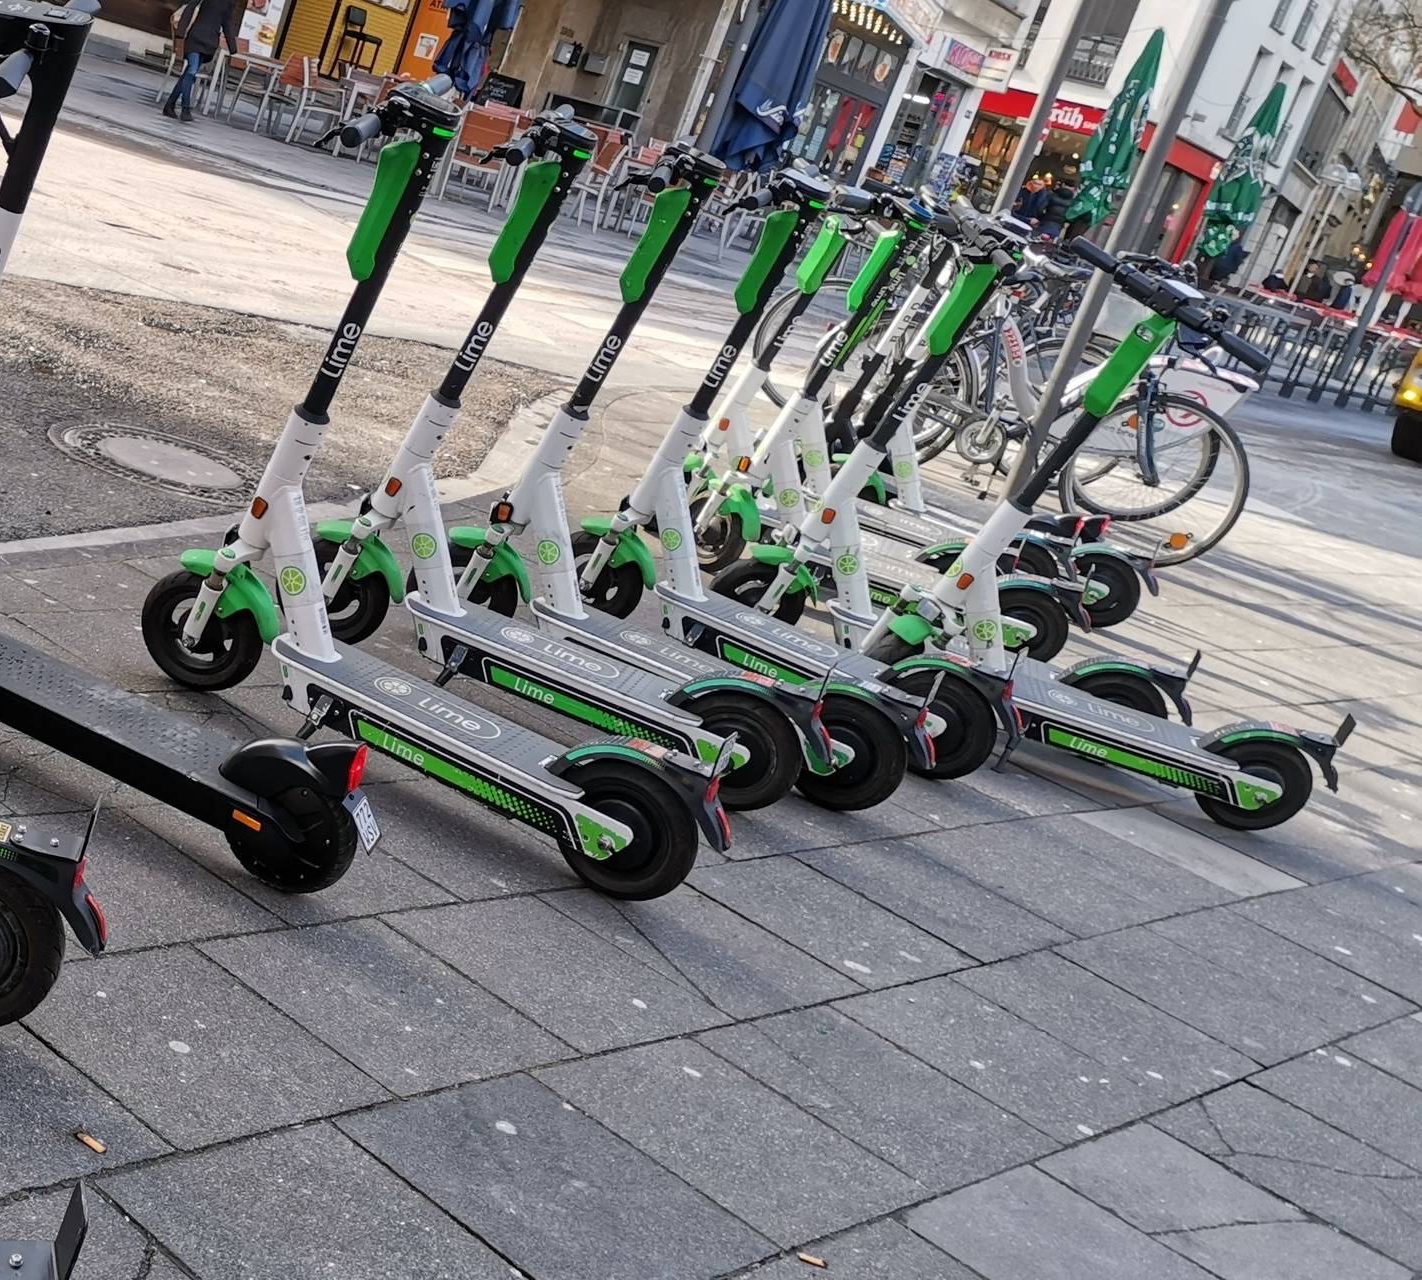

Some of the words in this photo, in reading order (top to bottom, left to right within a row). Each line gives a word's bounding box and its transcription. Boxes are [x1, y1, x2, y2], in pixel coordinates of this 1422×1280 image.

[321, 322, 361, 378] Lime
[455, 321, 493, 371] Lime
[585, 335, 622, 382] Lime
[819, 330, 849, 367] Lime
[703, 344, 738, 388] Lime
[772, 628, 822, 652] Lime
[543, 643, 603, 673] Lime
[742, 653, 778, 678] Lime
[514, 677, 555, 705] Lime
[418, 697, 481, 732] Lime
[383, 733, 425, 766] Lime
[1070, 736, 1109, 759] Lime
